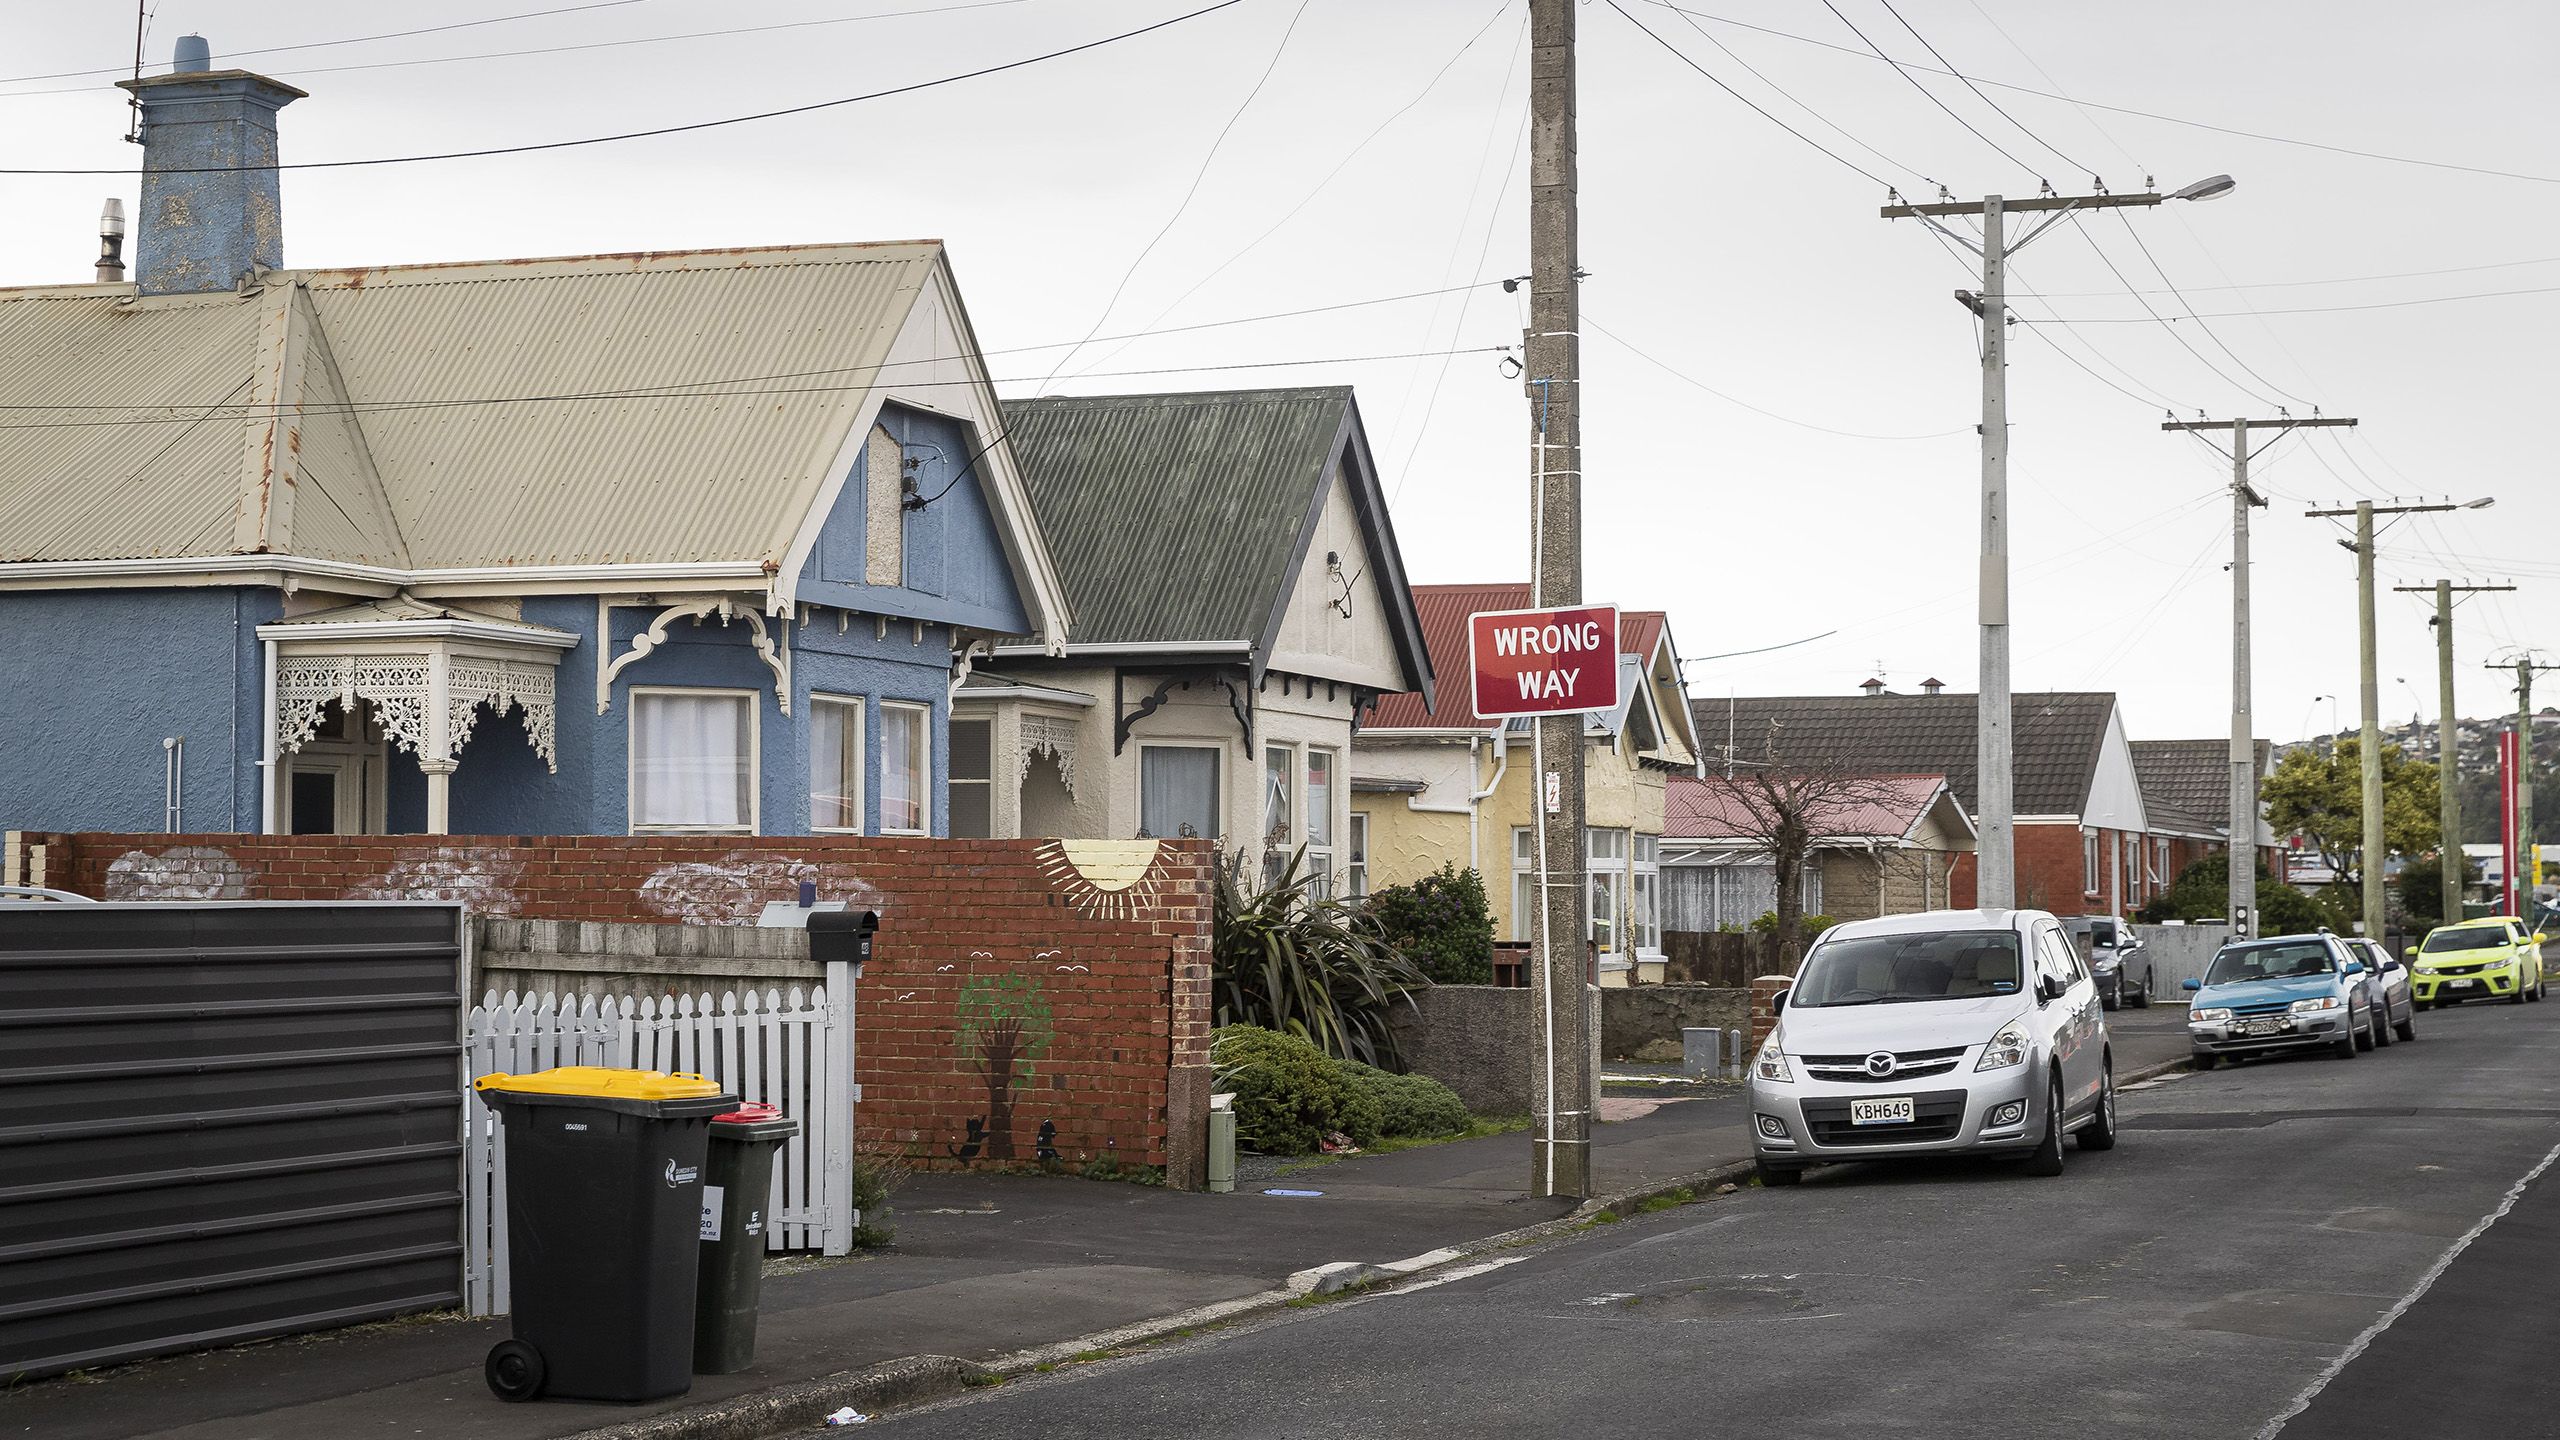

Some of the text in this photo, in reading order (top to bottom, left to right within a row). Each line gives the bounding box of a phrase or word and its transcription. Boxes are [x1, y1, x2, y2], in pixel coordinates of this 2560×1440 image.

[1493, 621, 1600, 657] WRONG
[1517, 667, 1580, 700] WAY
[1855, 1102, 1911, 1120] KBH649
